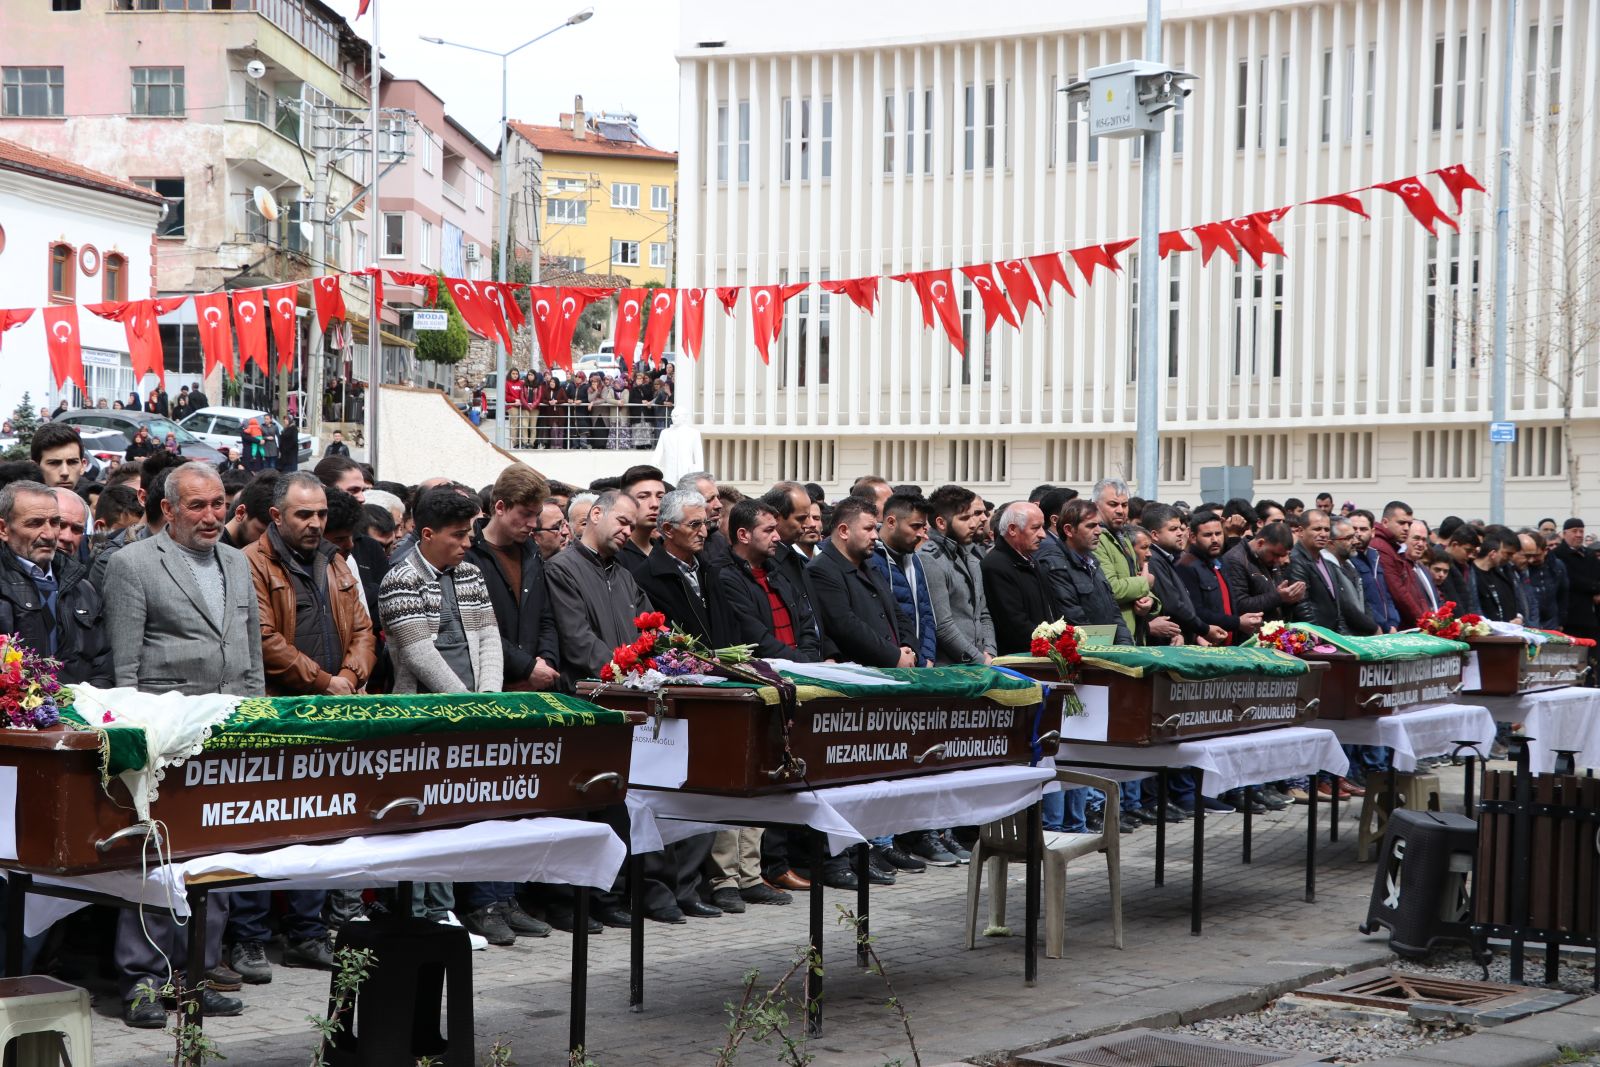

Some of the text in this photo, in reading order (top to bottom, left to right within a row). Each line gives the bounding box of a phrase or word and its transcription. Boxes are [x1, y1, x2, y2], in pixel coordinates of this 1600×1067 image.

[1256, 678, 1299, 698] BELEDİYESİ
[812, 706, 1015, 735] DENİZLİ BÜYÜKŞEHİR BELEDİYESİ
[1179, 709, 1233, 726] MEZARLIKLAR
[185, 737, 563, 787] DENİZLİ BÜYÜKŞEHİR BELEDİYESİ
[826, 735, 1009, 764] MEZARLIKLAR MÜDÜRLÜĞÜ
[202, 774, 540, 827] MEZARLIKLAR MÜDÜRLÜĞÜ
